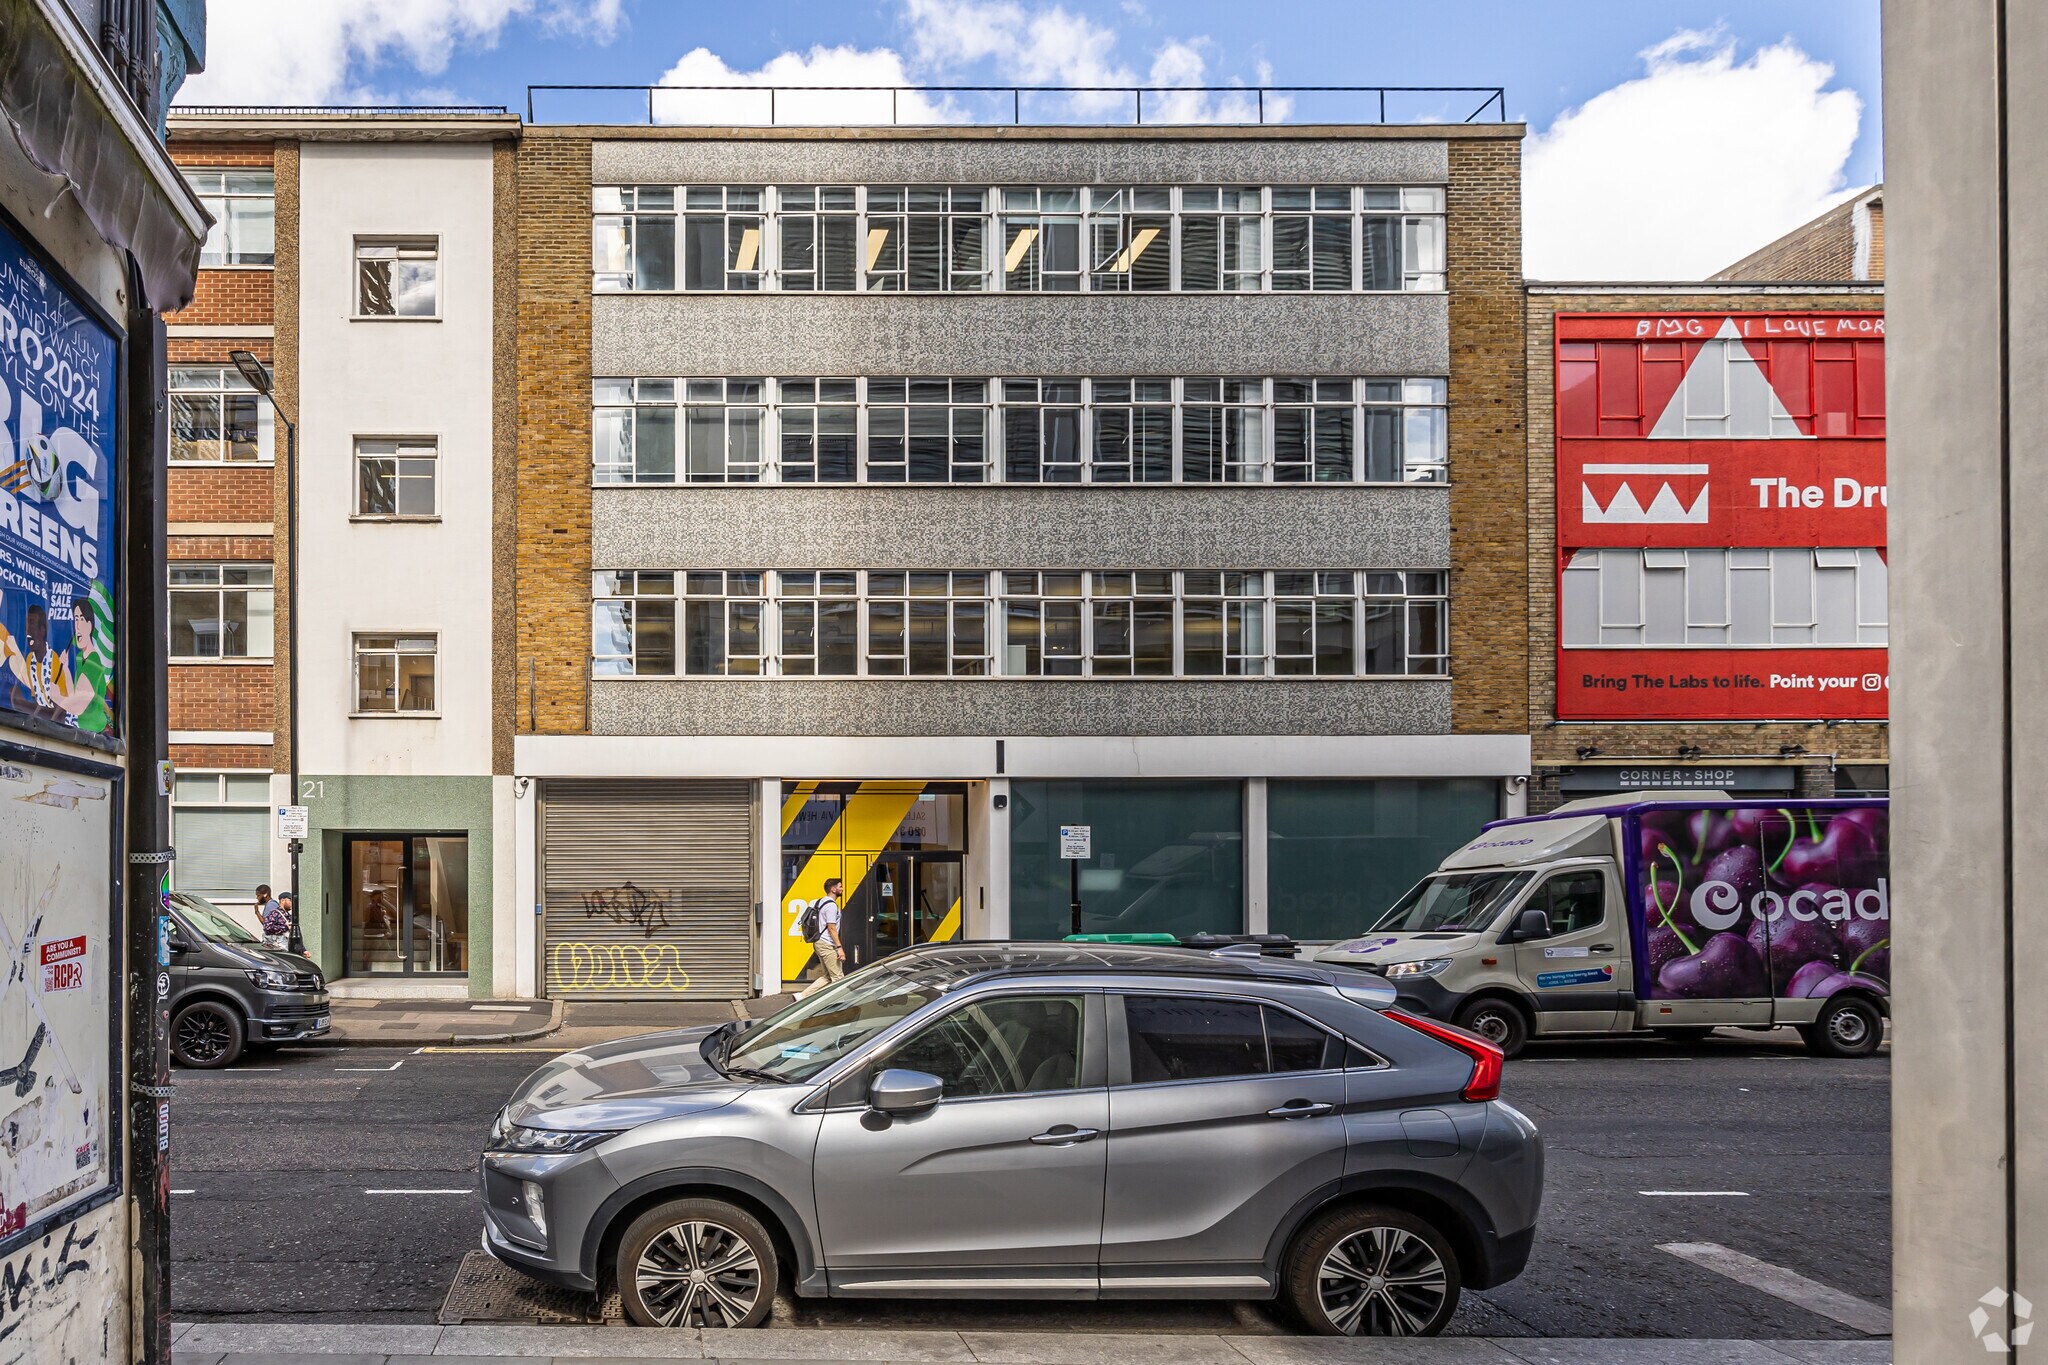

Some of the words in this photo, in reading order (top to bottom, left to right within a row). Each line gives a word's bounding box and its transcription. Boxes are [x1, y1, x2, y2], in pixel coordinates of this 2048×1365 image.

[1765, 318, 1826, 337] LOVE
[9, 293, 46, 336] AND
[49, 326, 100, 389] WATCH
[71, 330, 100, 365] JULY
[41, 383, 65, 419] ON
[70, 404, 100, 448] THE
[1750, 477, 1824, 508] The
[16, 557, 48, 585] WINES,
[52, 581, 73, 596] YARD
[51, 595, 72, 608] SALE
[48, 607, 74, 621] PIZZA
[1582, 673, 1628, 692] Bring
[1632, 674, 1665, 689] The
[1669, 673, 1709, 689] Labs
[1713, 674, 1730, 689] to
[1734, 673, 1765, 689] life.
[1769, 673, 1815, 689] Point
[1817, 676, 1859, 692] your
[1620, 770, 1681, 780] CORNER
[1694, 770, 1734, 780] SHOP
[302, 780, 324, 798] 21
[46, 943, 57, 954] ARE
[57, 940, 69, 951] YOU
[46, 946, 82, 962] COMMUNIST?
[54, 963, 73, 988] RCP
